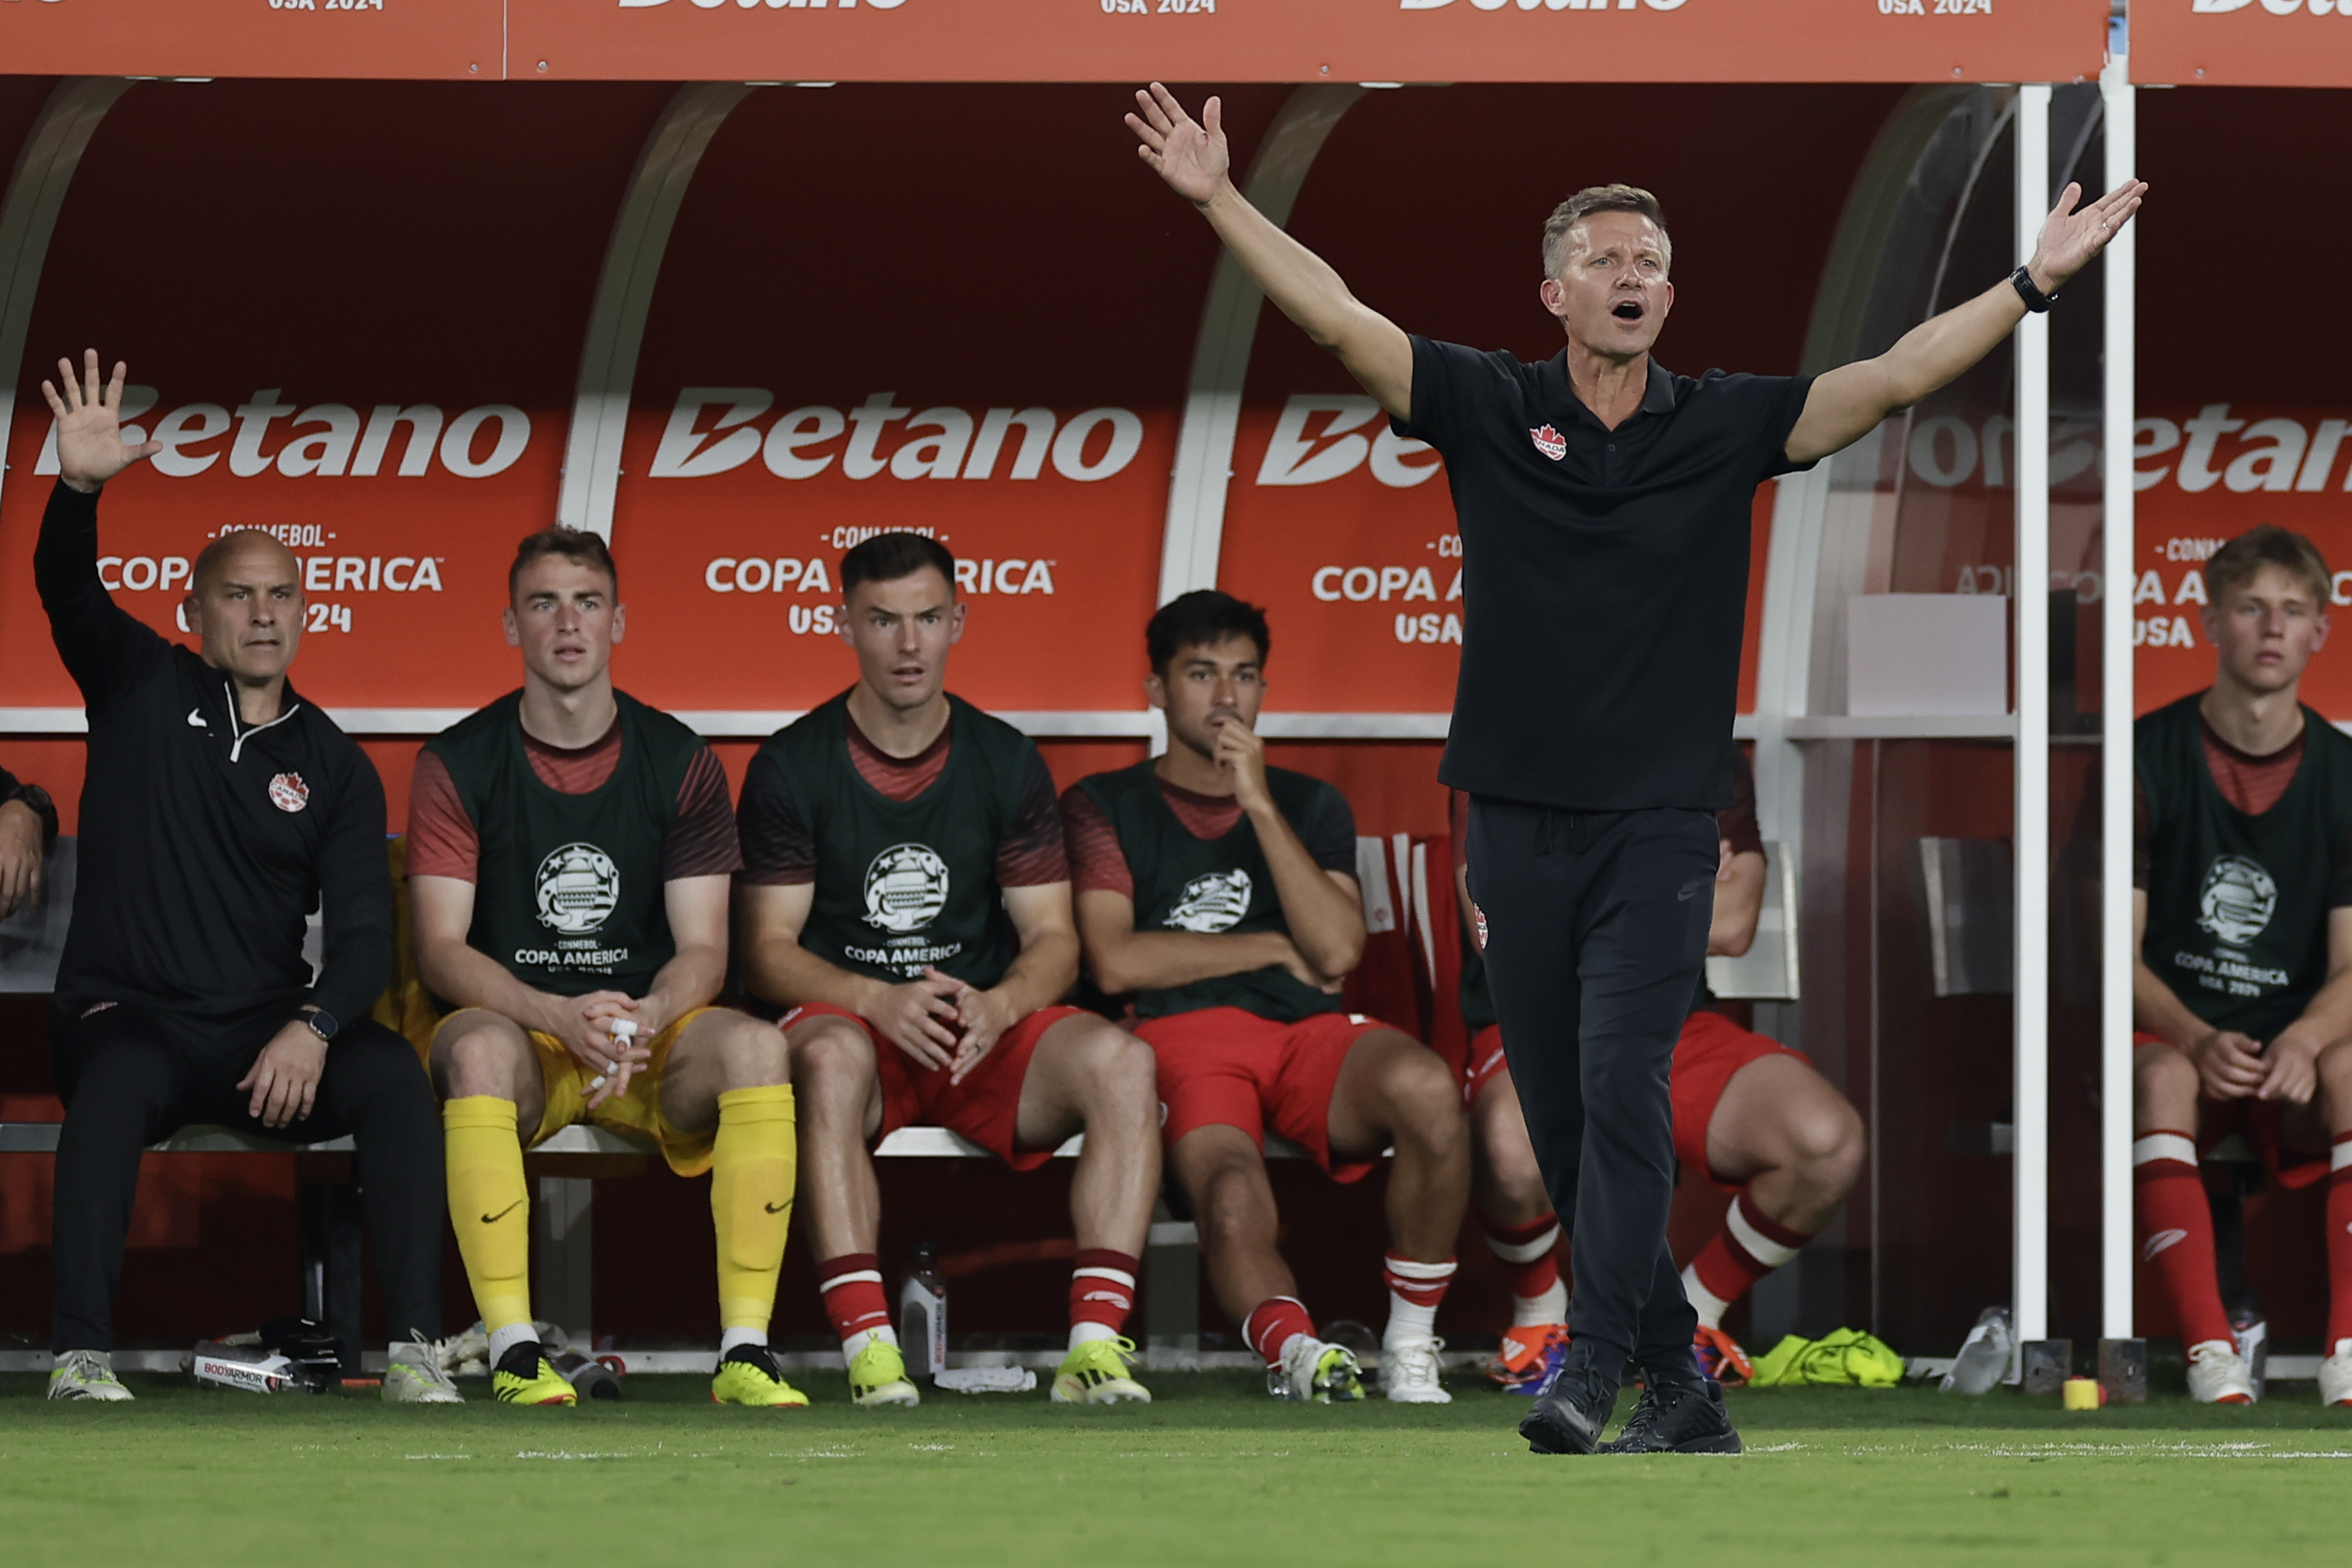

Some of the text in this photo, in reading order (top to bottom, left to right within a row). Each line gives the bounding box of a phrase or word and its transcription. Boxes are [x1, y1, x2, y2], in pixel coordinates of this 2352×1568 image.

[1877, 0, 1993, 15] USA 2024
[648, 386, 1143, 482] Betano
[294, 556, 443, 591] ERICA
[704, 558, 1055, 594] COPA RICA
[1312, 564, 1438, 602] COPA
[788, 604, 843, 635] US
[1394, 613, 1463, 646] USA
[515, 948, 629, 965] COPA AMERICA
[844, 942, 962, 965] COPA AMERICA
[204, 1362, 263, 1384] BODYARMOR
